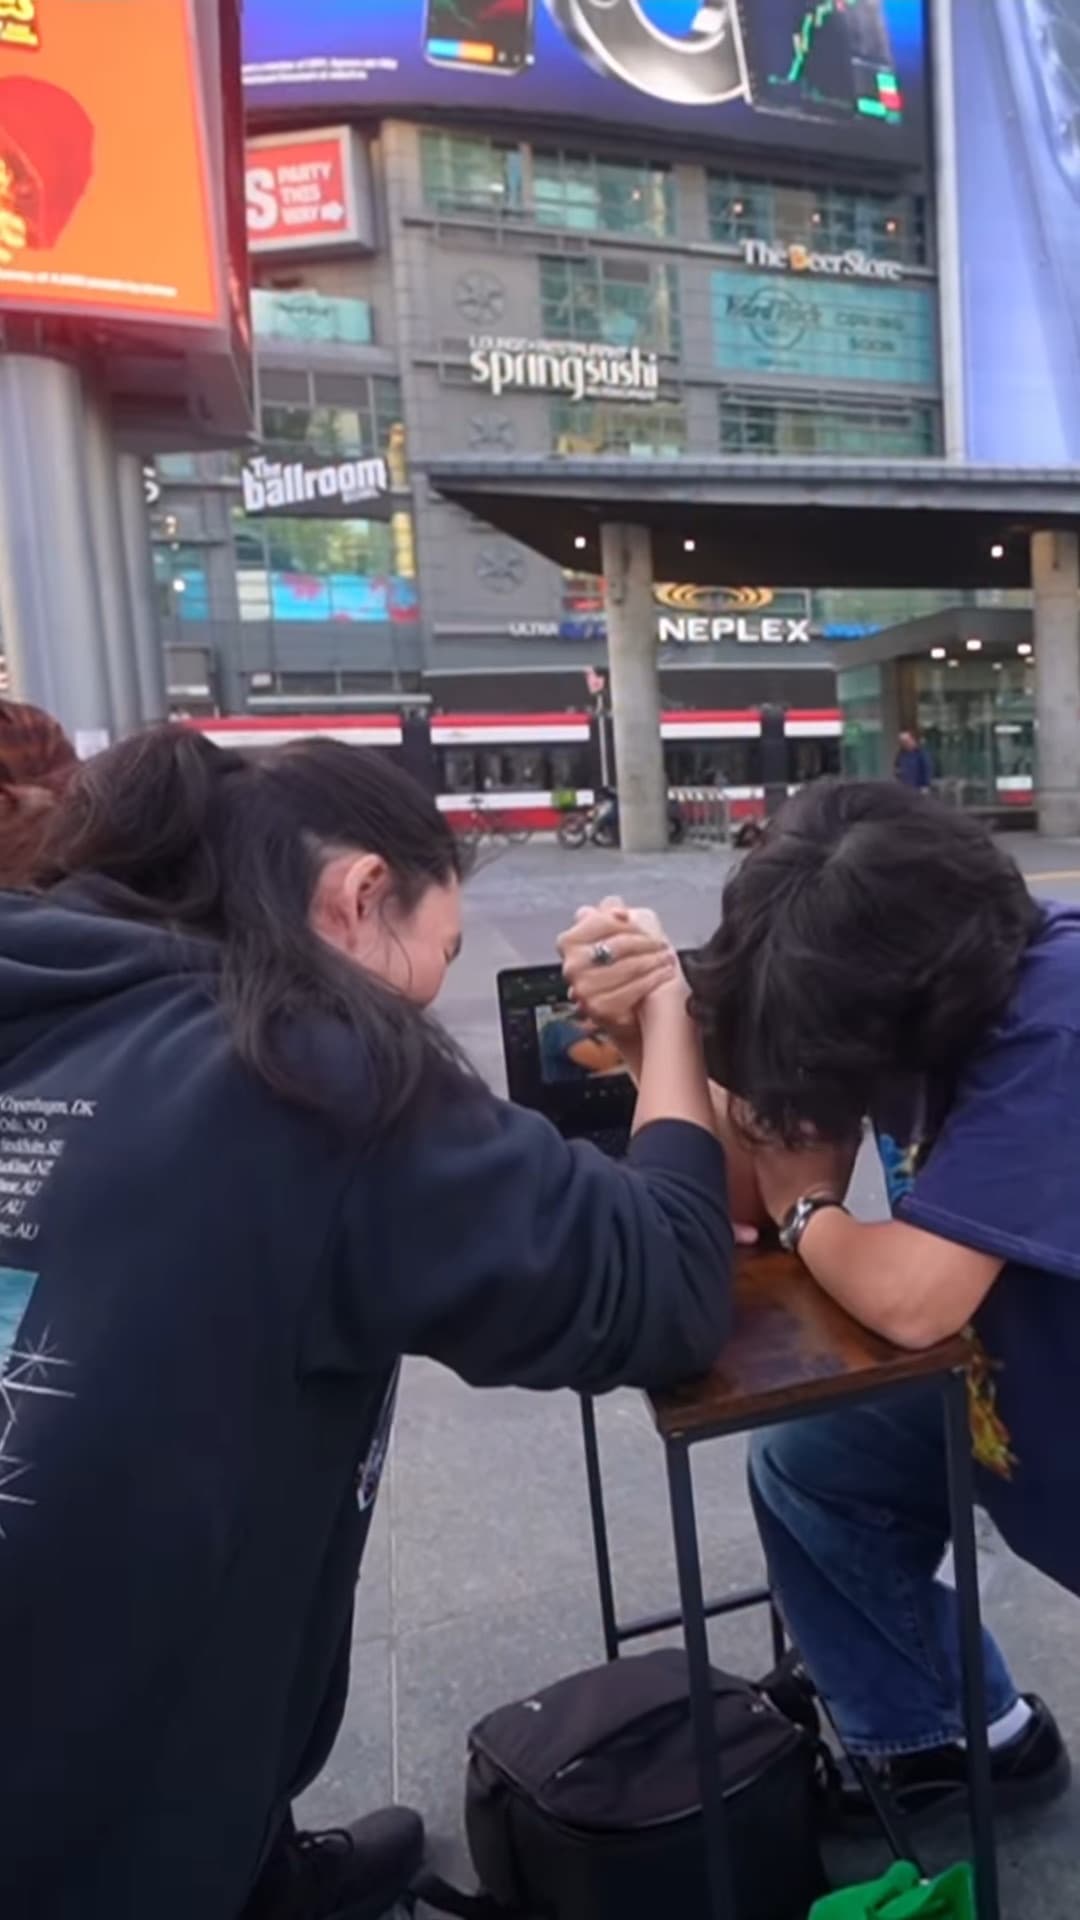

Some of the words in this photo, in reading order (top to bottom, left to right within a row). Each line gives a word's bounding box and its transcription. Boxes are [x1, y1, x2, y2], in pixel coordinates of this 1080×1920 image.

[277, 162, 332, 184] PARTY
[281, 184, 321, 204] THIS
[282, 206, 319, 226] WAY
[741, 239, 788, 267] The
[241, 458, 387, 512] ballroom
